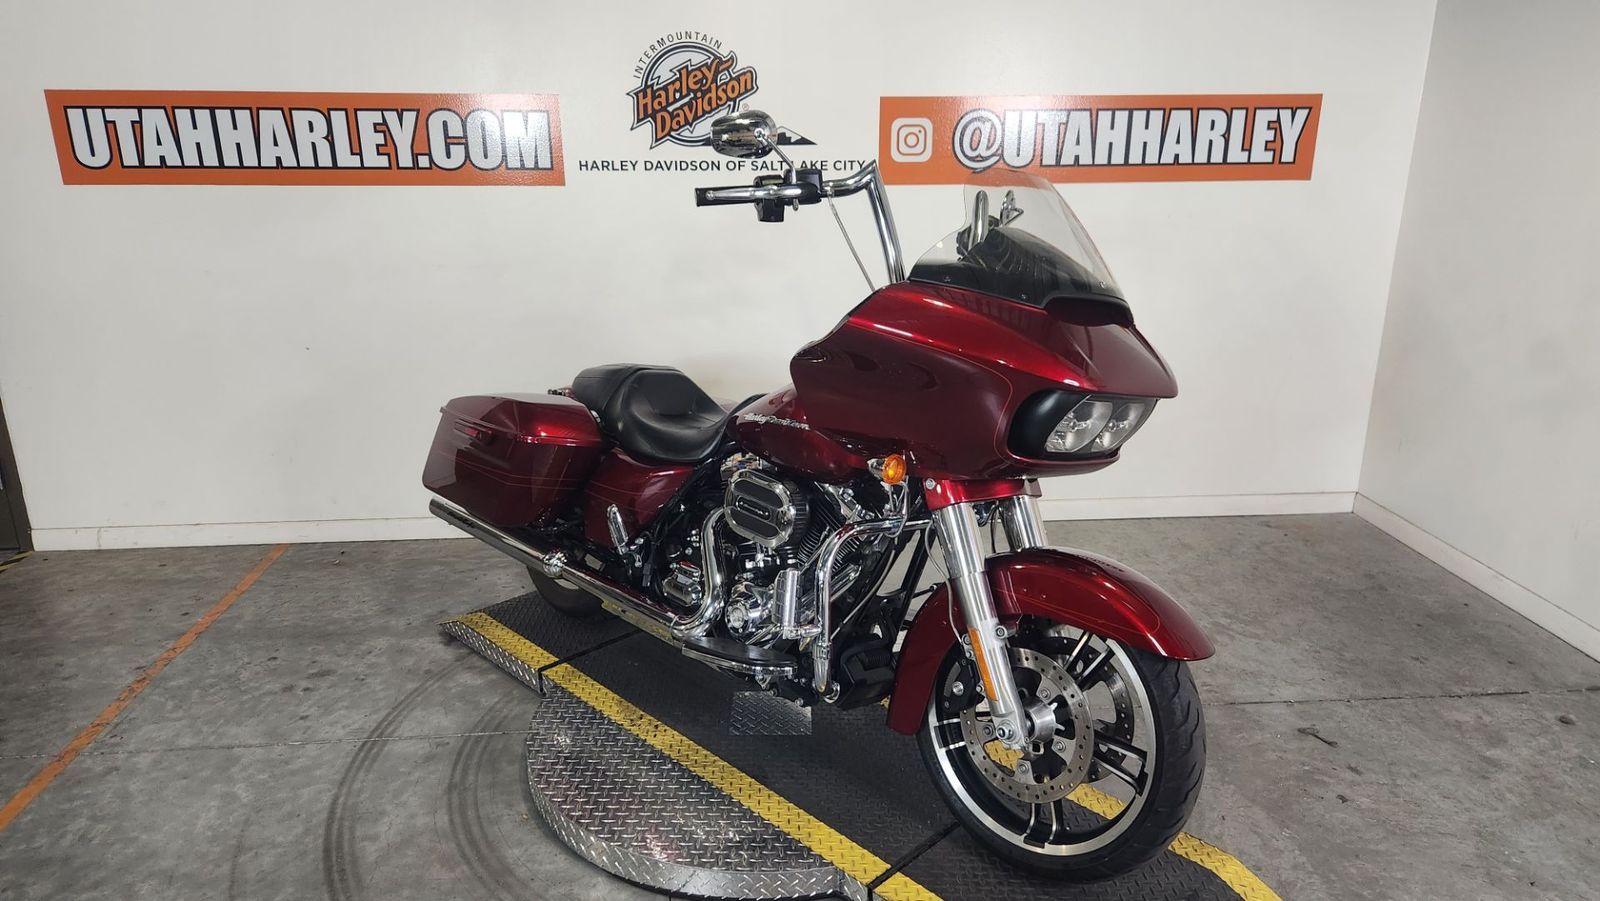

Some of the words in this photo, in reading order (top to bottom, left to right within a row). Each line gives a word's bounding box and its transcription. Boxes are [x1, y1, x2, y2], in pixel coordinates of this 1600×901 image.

[633, 31, 722, 79] INTERMOUNTAIN
[654, 69, 754, 141] Davidson
[64, 106, 553, 170] UTAHHARLEY.COM
[578, 160, 639, 171] HARLEY
[643, 160, 721, 171] DAVIDSON
[725, 160, 747, 171] OF
[750, 160, 784, 171] SALT
[791, 160, 829, 171] AKE
[832, 160, 866, 171] CITY
[952, 107, 1312, 173] @UTAHHARLEY
